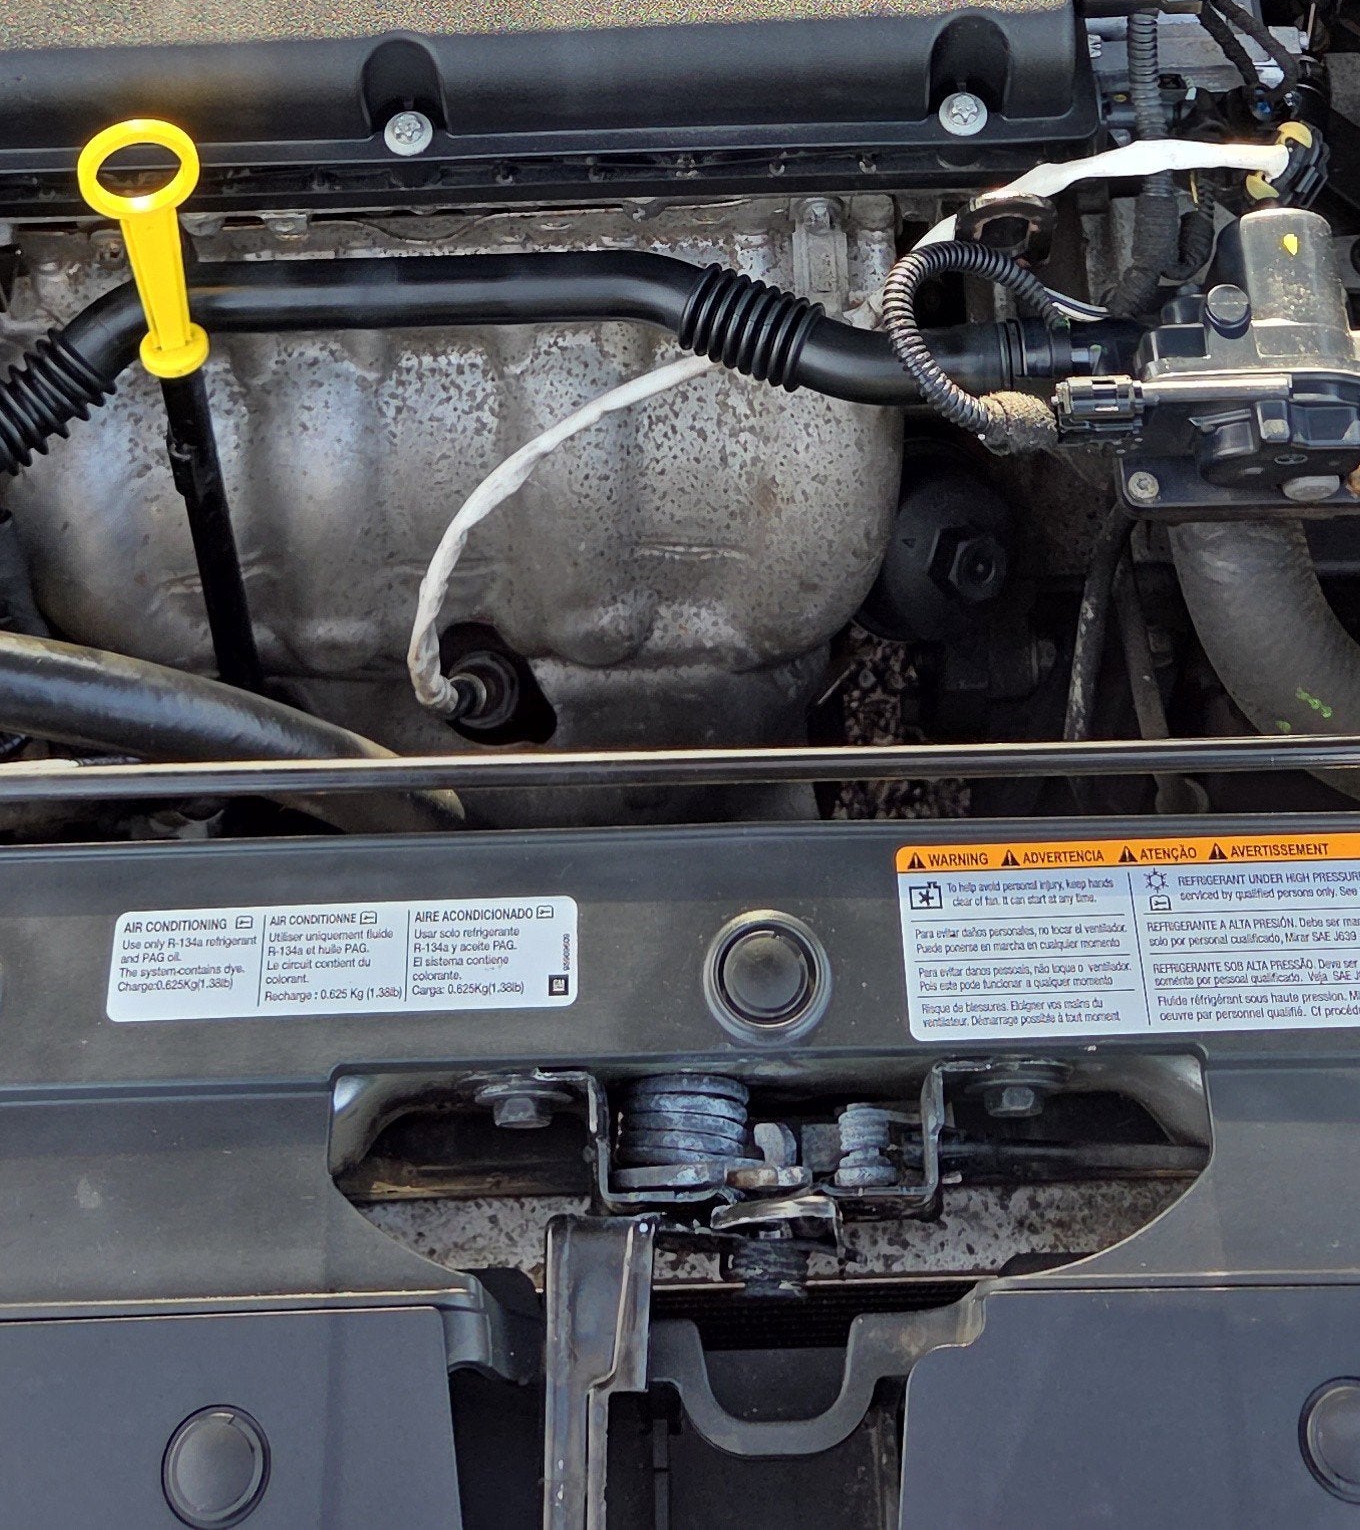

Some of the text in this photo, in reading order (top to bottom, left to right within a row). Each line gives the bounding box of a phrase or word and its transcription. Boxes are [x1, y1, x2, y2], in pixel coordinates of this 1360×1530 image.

[1140, 844, 1197, 861] ATENÇÃO
[1231, 842, 1329, 857] AVERTISSEMENT
[928, 852, 988, 866] WARNING
[1023, 850, 1104, 864] ADVERTENCIA
[947, 882, 956, 892] To
[959, 882, 976, 893] help
[979, 881, 1000, 891] avoid
[1003, 880, 1037, 892] personal
[1066, 879, 1086, 890] keep
[1088, 878, 1113, 888] hands
[1178, 874, 1245, 886] REFRIGERANT
[1248, 873, 1283, 884] UNDER
[1286, 872, 1310, 883] HIGH
[953, 898, 972, 907] clear
[975, 897, 982, 906] of
[1011, 897, 1025, 905] can
[1028, 895, 1046, 904] start
[1048, 895, 1057, 903] at
[1059, 895, 1073, 904] any
[1076, 893, 1097, 903] time.
[1180, 890, 1219, 900] serviced
[1221, 890, 1232, 901] by
[1236, 889, 1274, 901] qualified
[1278, 888, 1314, 900] persons
[1316, 886, 1338, 898] only.
[1339, 886, 1357, 896] See
[270, 914, 356, 925] AIR CONDITIONNE
[415, 908, 533, 922] AIRE ACONDICIONADO
[124, 919, 226, 933] AIR CONDITIONING
[1147, 920, 1217, 931] REFRIGERANTE
[1220, 919, 1226, 929] A
[1229, 918, 1251, 929] ALTA
[1253, 916, 1297, 928] PRESIÓN.
[1299, 917, 1324, 928] Debe
[1326, 918, 1340, 926] ser
[269, 928, 393, 942] Utiliser uniquement fluide
[414, 927, 519, 939] Usar solo refrigerante
[1149, 931, 1356, 948] solo por personal cualificado, Mirar SAE J639
[122, 936, 256, 950] Use only R-134a refrigerant
[268, 943, 369, 956] R-134a et huile PAG.
[414, 941, 517, 954] R-134a y aceite PAG.
[121, 953, 139, 964] and
[142, 952, 164, 962] PAG
[267, 958, 370, 970] Le circuit contient du
[414, 955, 509, 967] El sistema contiene
[119, 964, 244, 978] The system contains dye.
[1153, 962, 1222, 974] REFRIGERANTE
[1224, 962, 1244, 971] SOB
[1246, 961, 1268, 971] ALTA
[1270, 958, 1314, 971] PRESSÃO.
[1318, 959, 1340, 969] Deve
[1343, 960, 1357, 968] ser
[266, 974, 308, 984] colorant.
[413, 971, 462, 981] colorante.
[1196, 976, 1211, 987] por
[1214, 974, 1248, 986] pessoal
[1251, 972, 1303, 984] qualificado.
[1308, 971, 1328, 984] Veja
[1333, 971, 1351, 981] SAE
[265, 987, 402, 1002] Recharge 0.625 Kg (1.38lb)
[412, 985, 443, 997] Carga:
[1158, 996, 1188, 1006] Fluide
[1191, 994, 1243, 1006] réfrigérant
[1245, 995, 1268, 1003] sous
[1271, 993, 1299, 1003] haute
[1302, 992, 1346, 1004] pression.
[1197, 1011, 1213, 1021] par
[1216, 1008, 1264, 1021] personnel
[1267, 1006, 1307, 1020] qualifié.
